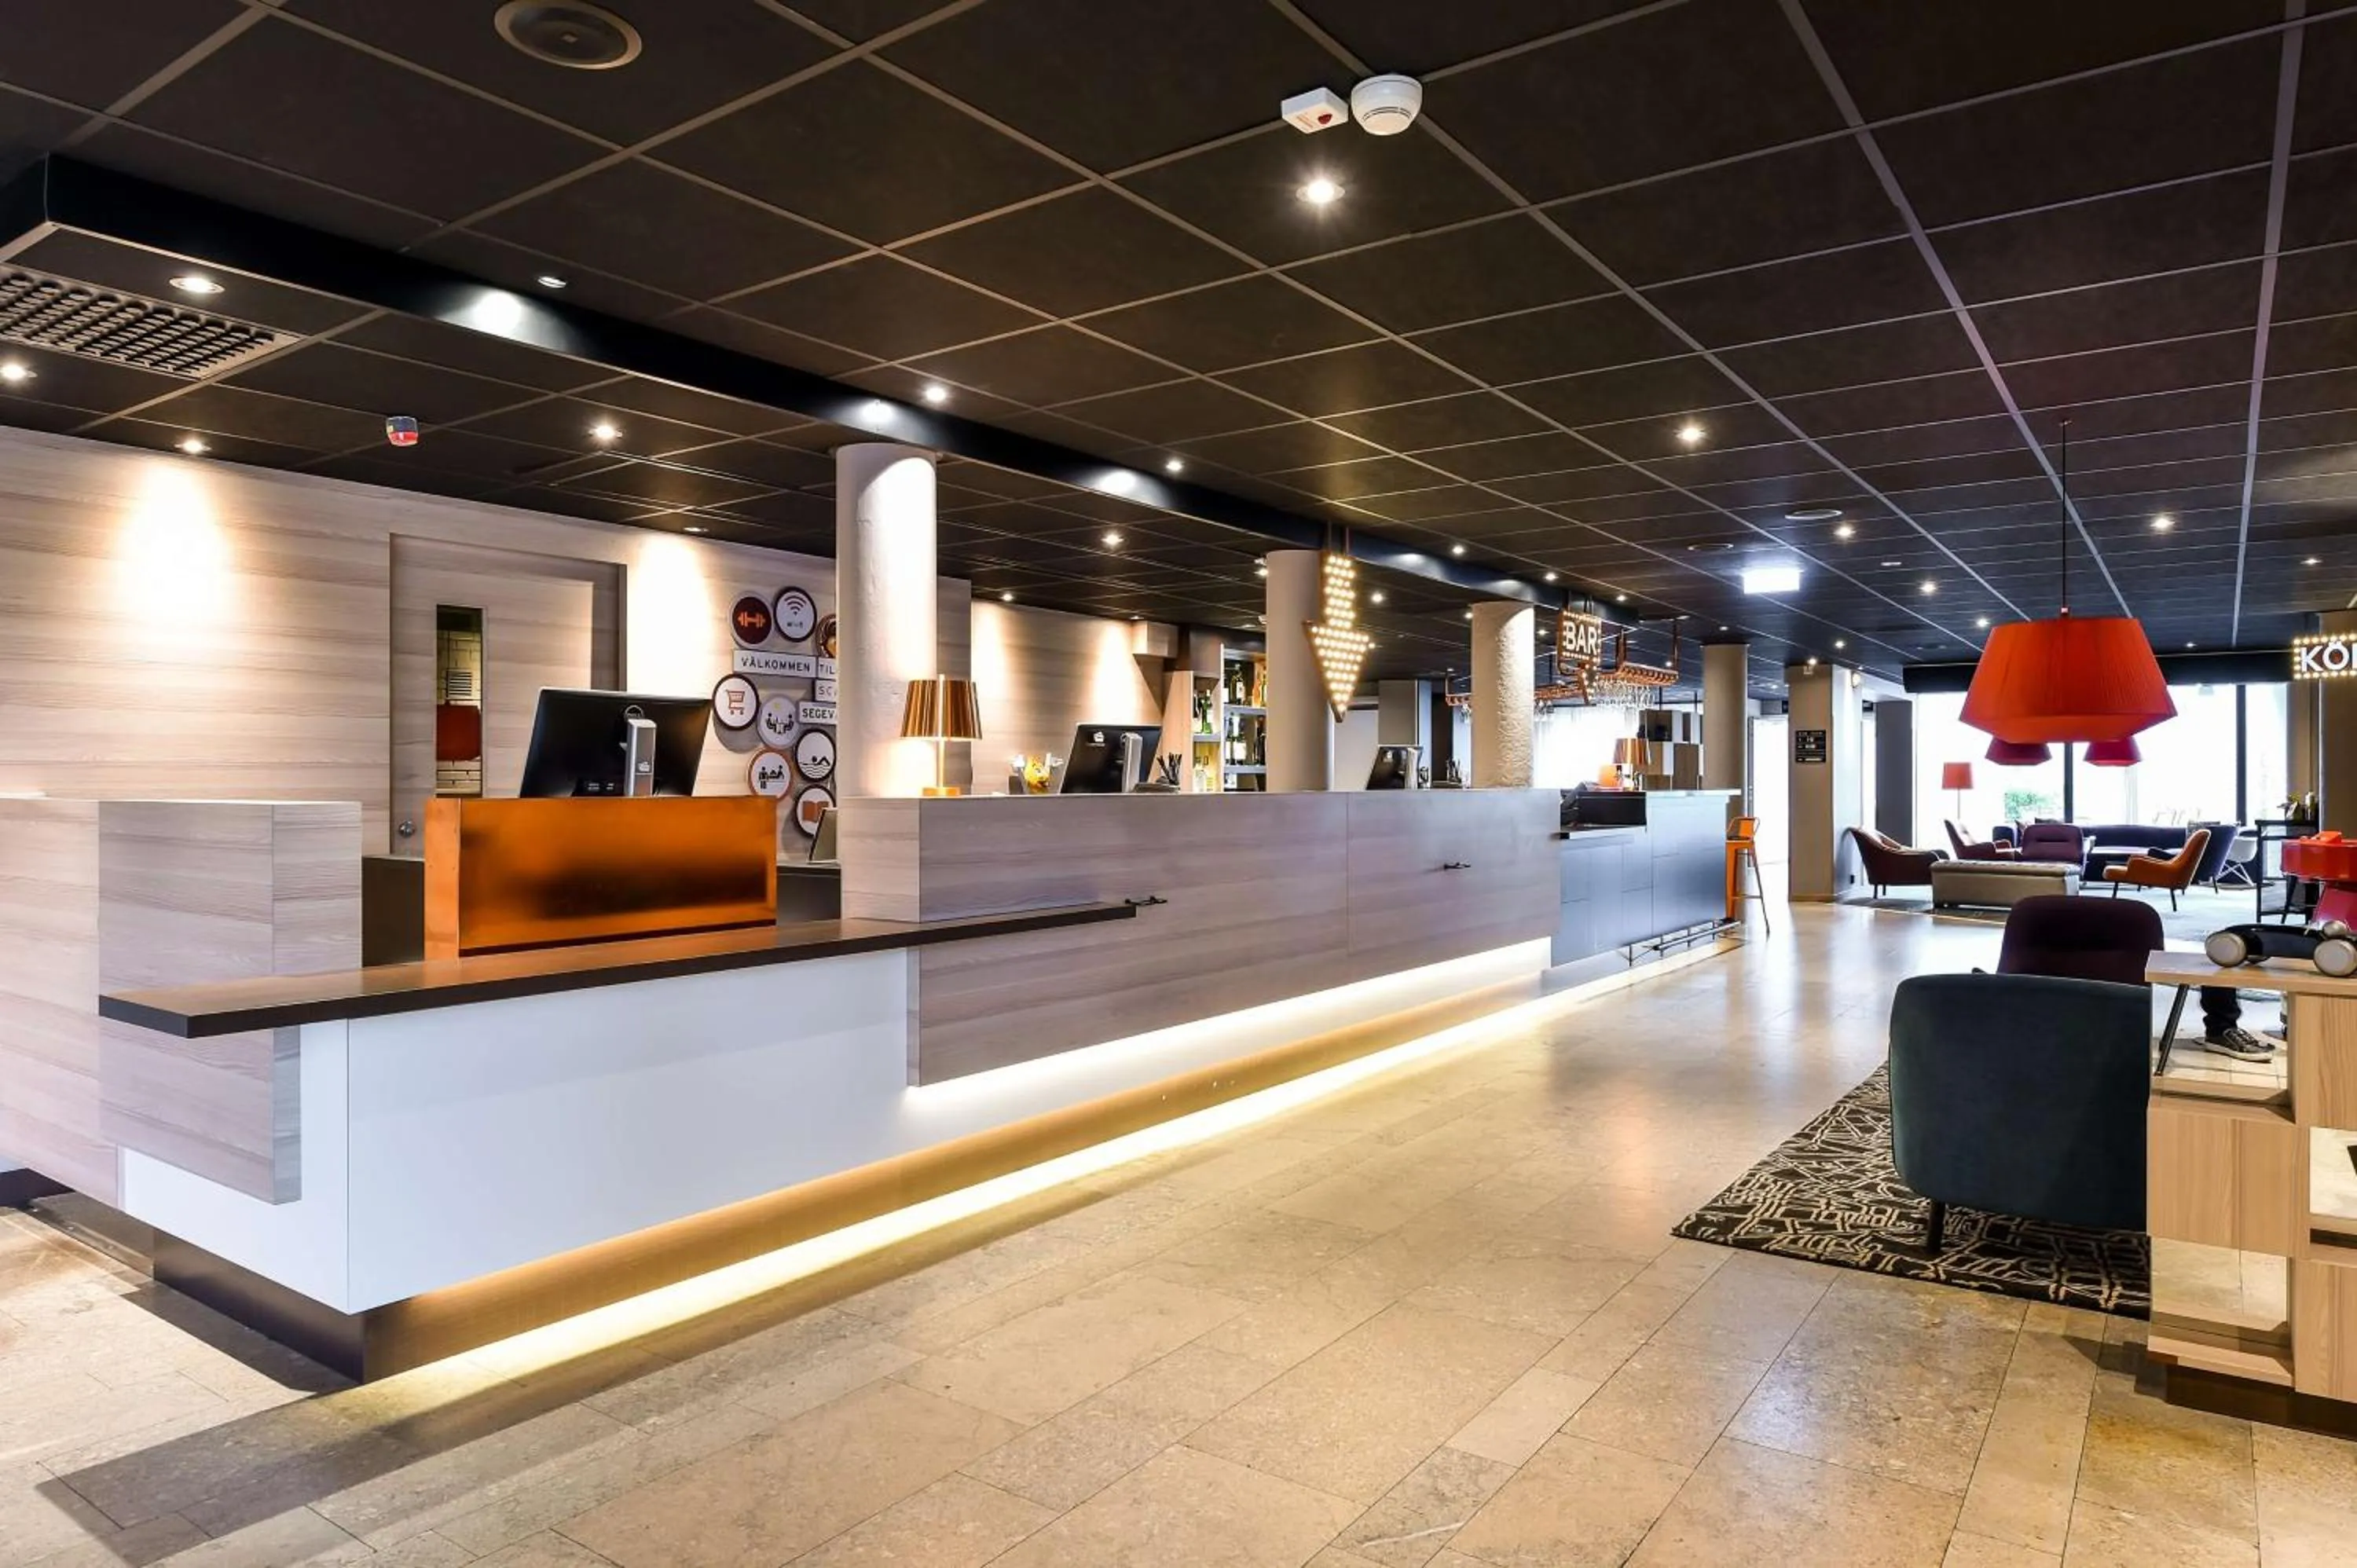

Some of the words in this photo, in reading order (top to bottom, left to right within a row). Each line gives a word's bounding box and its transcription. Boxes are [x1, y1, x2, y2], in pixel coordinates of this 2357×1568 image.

[1566, 621, 1597, 655] BAR
[2300, 641, 2357, 672] KÖ
[819, 686, 836, 696] SC
[802, 708, 836, 719] SEGEV
